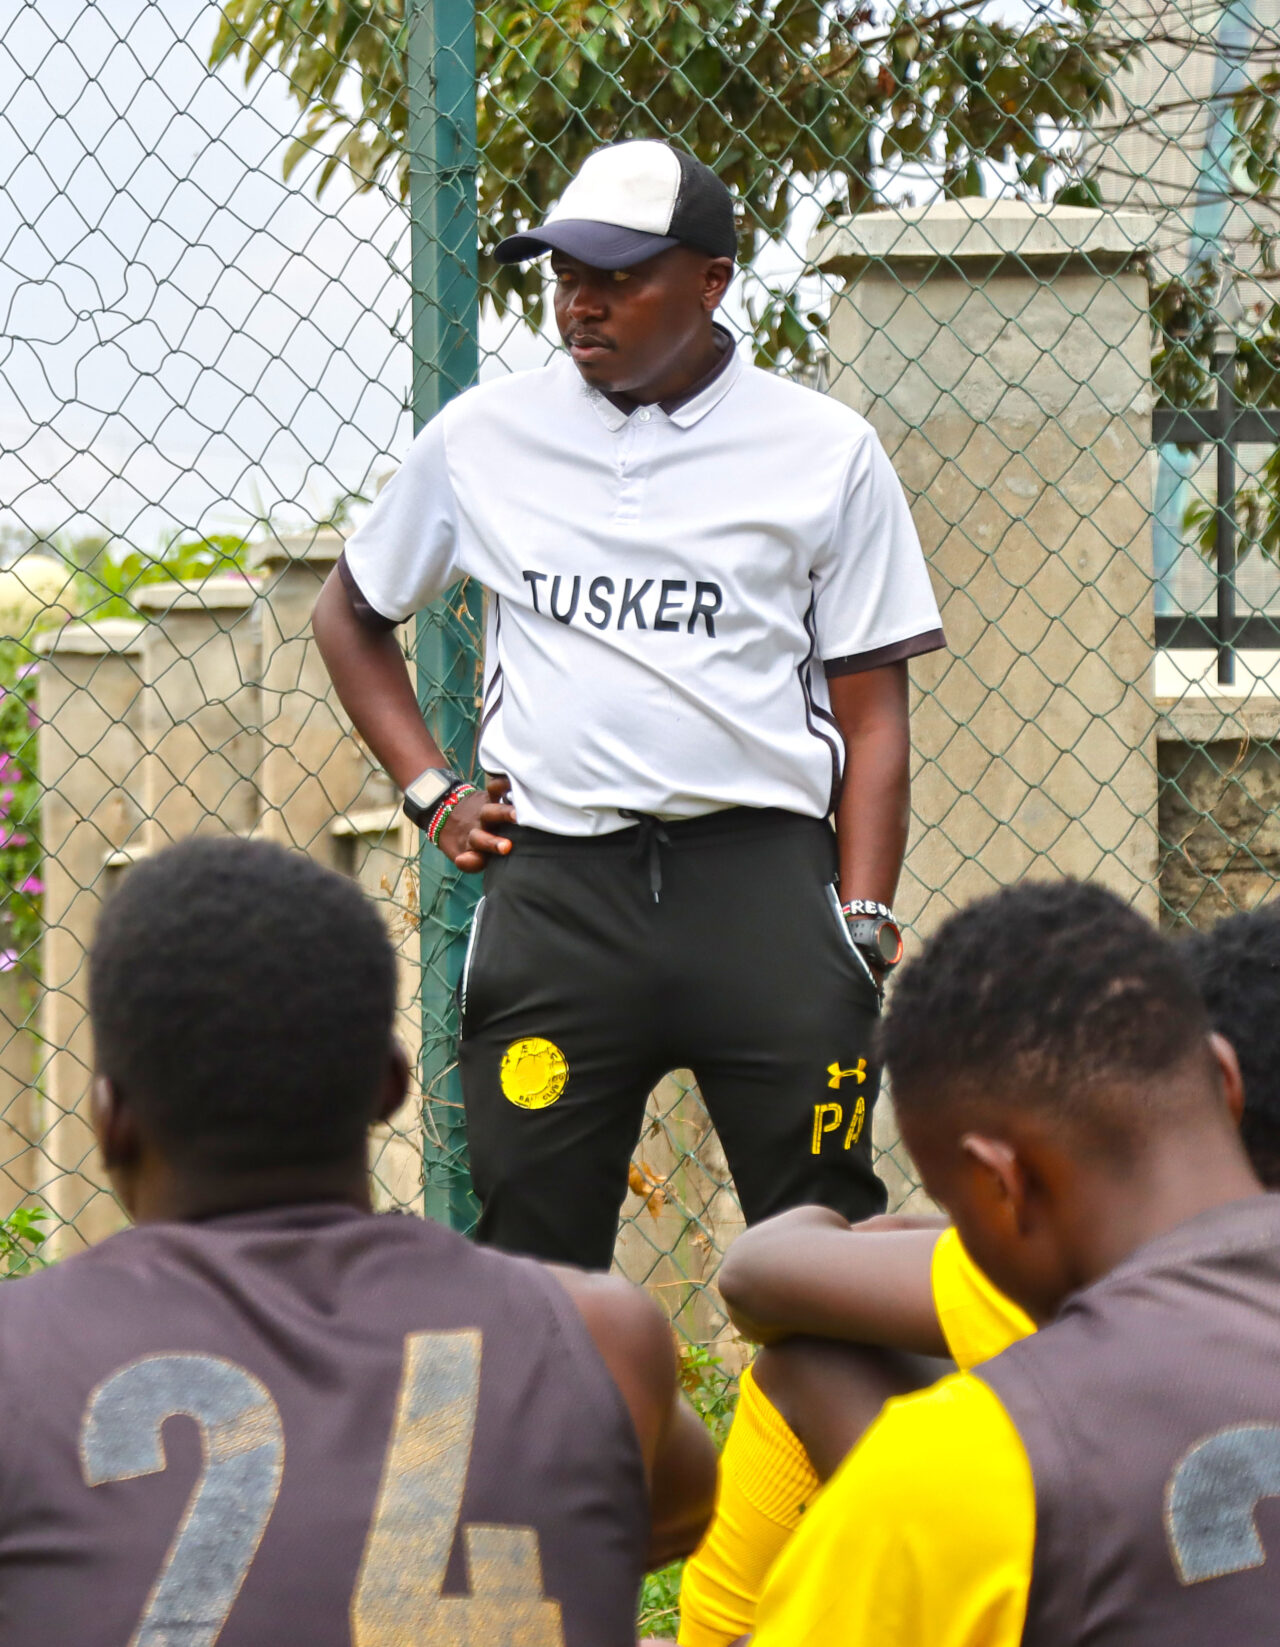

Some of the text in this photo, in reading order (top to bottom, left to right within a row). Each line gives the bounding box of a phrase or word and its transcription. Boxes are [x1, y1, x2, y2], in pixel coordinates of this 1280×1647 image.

[523, 570, 723, 638] TUSKER
[811, 1096, 866, 1155] PA
[79, 1327, 566, 1647] 24
